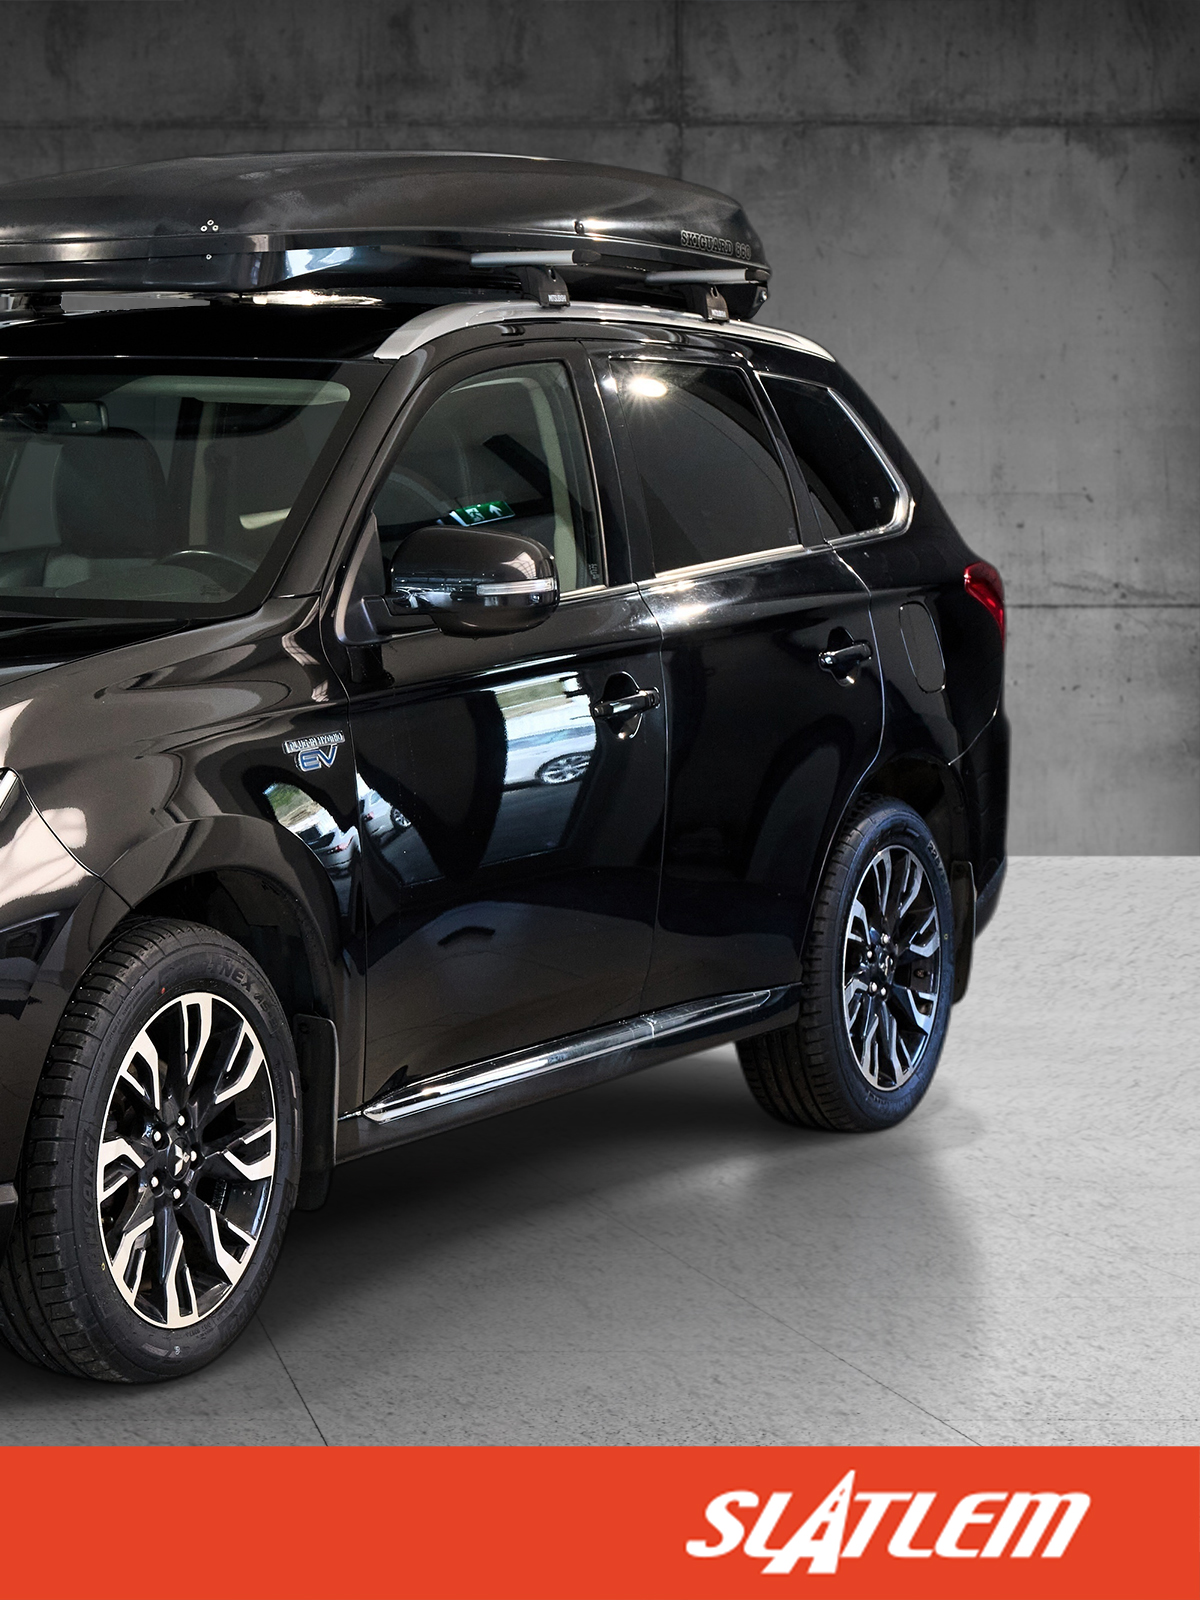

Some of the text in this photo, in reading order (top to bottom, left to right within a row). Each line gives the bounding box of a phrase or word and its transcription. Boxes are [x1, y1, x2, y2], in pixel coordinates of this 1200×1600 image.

[681, 230, 751, 260] SKIGUARD 860
[298, 744, 338, 772] EV
